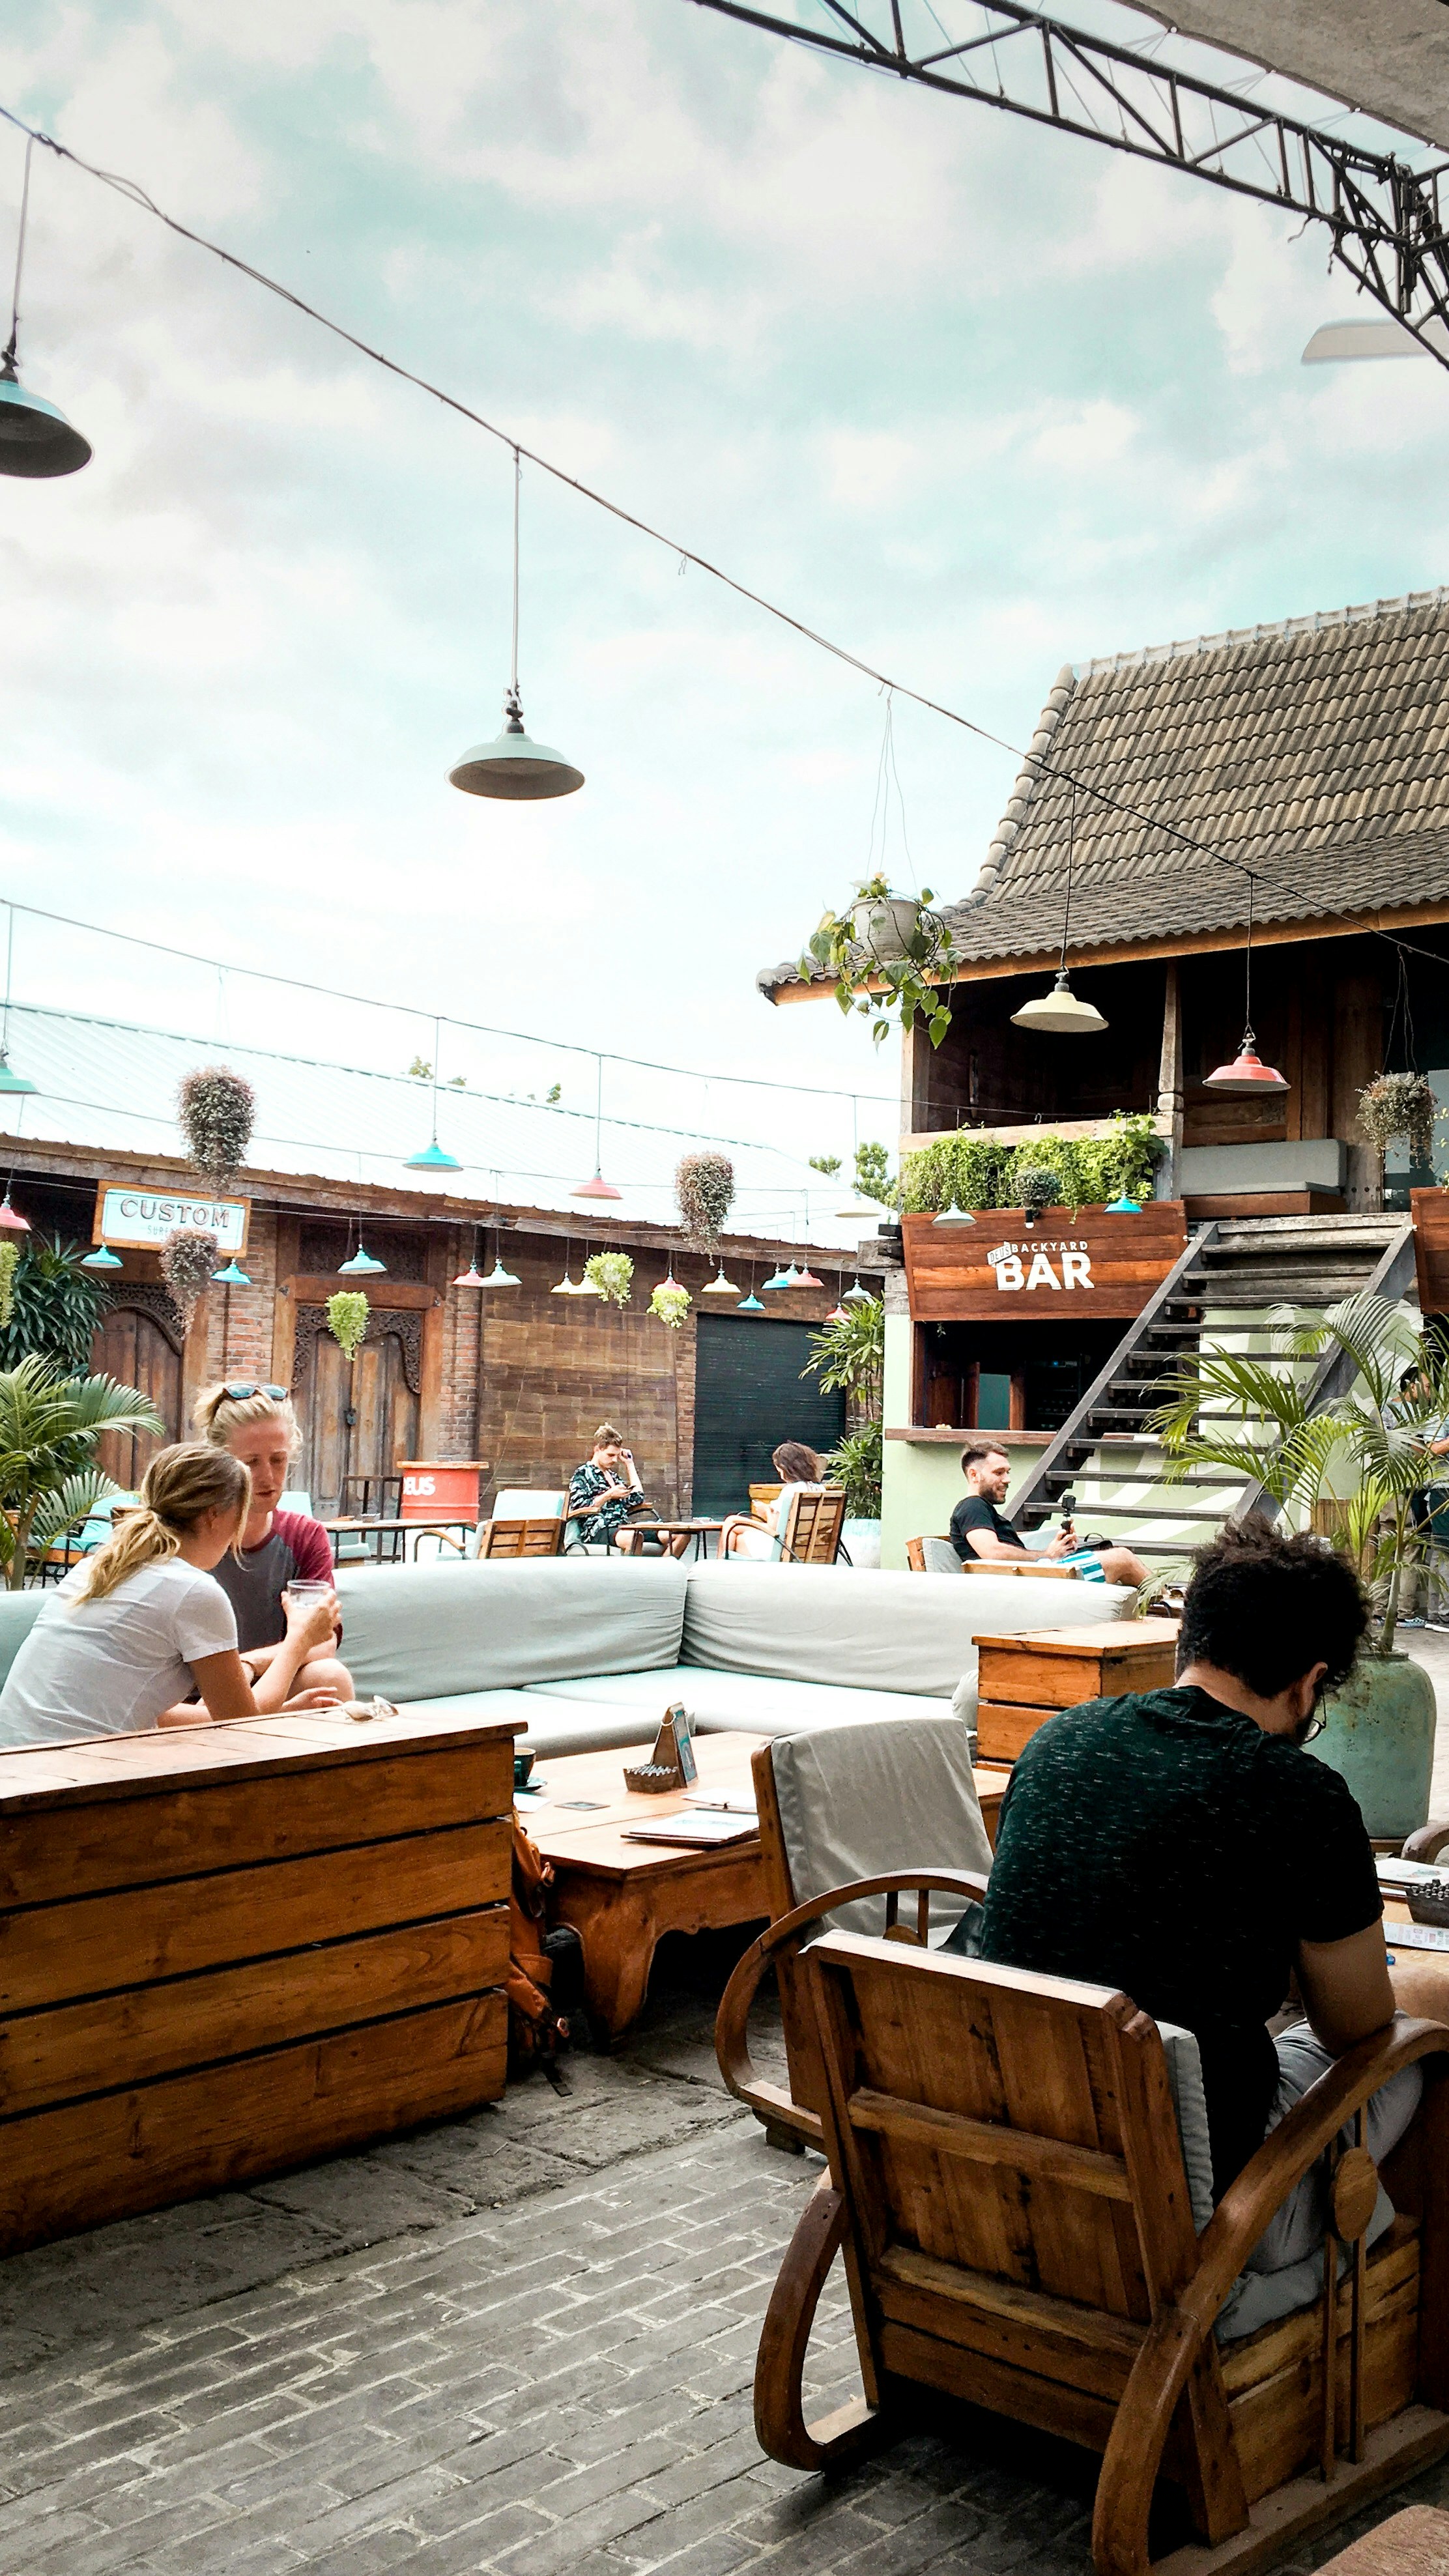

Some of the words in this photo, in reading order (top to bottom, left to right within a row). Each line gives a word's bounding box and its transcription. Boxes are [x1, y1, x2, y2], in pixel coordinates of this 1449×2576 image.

[121, 1197, 229, 1228] CUSTOM
[990, 1246, 1010, 1263] DEUS
[1011, 1240, 1088, 1253] BACKYARD
[996, 1252, 1095, 1291] BAR
